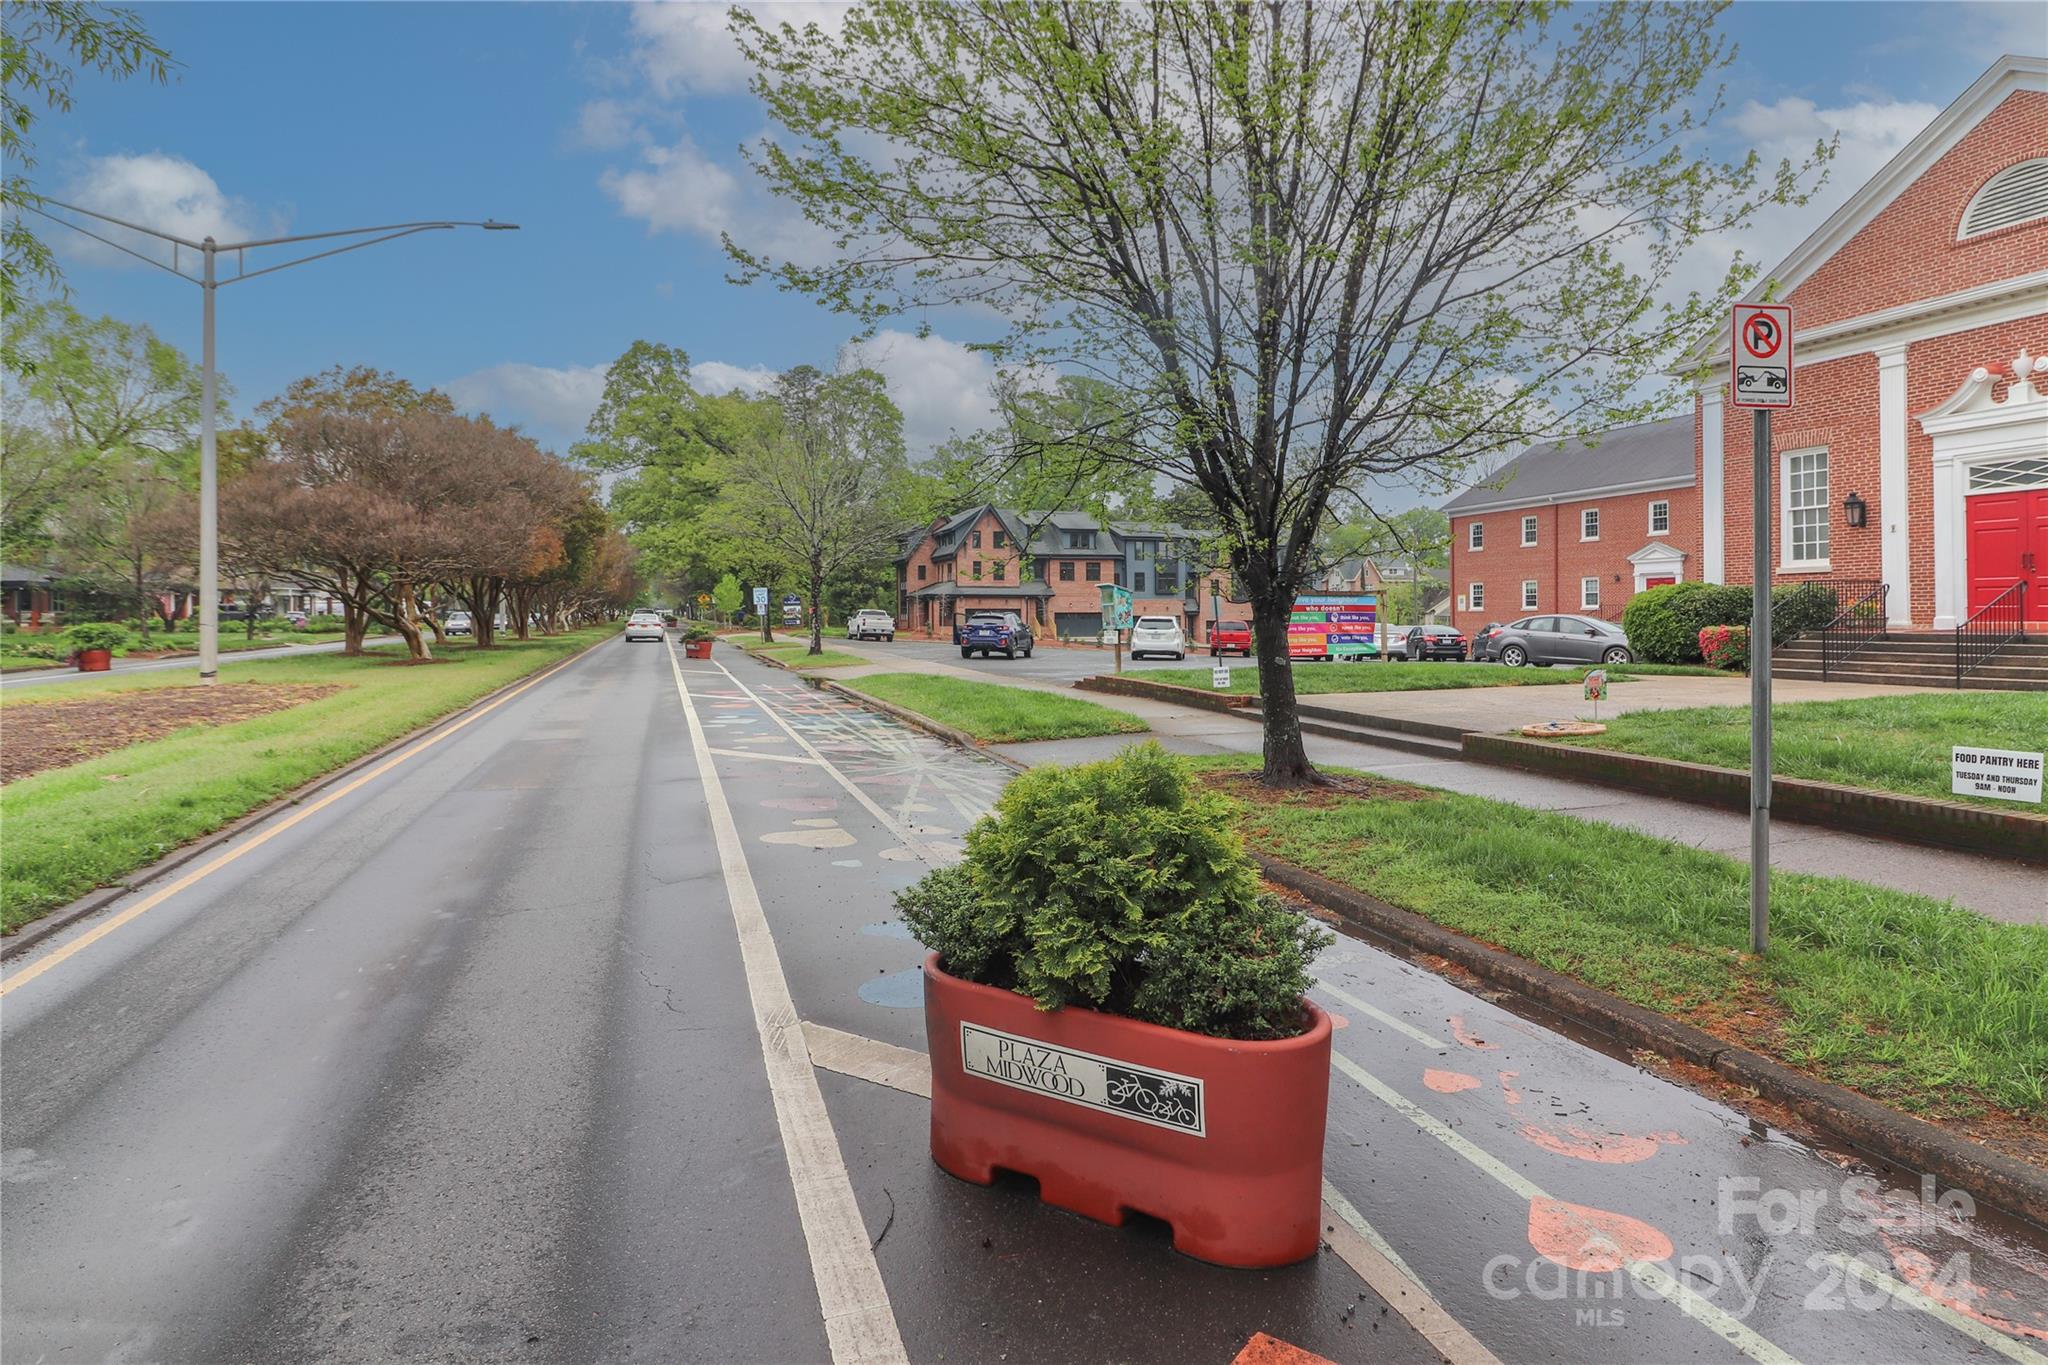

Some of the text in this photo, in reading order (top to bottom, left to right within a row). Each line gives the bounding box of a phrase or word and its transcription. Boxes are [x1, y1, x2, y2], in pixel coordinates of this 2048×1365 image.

[1955, 753, 2040, 770] FOOD PANTRY HERE
[1956, 771, 2038, 786] TUESDAY AND THURSDAY
[1975, 782, 1991, 791] 9AM
[1998, 785, 2017, 794] NOON
[998, 1039, 1067, 1075] PLAZA
[986, 1055, 1085, 1098] MIDWOOD
